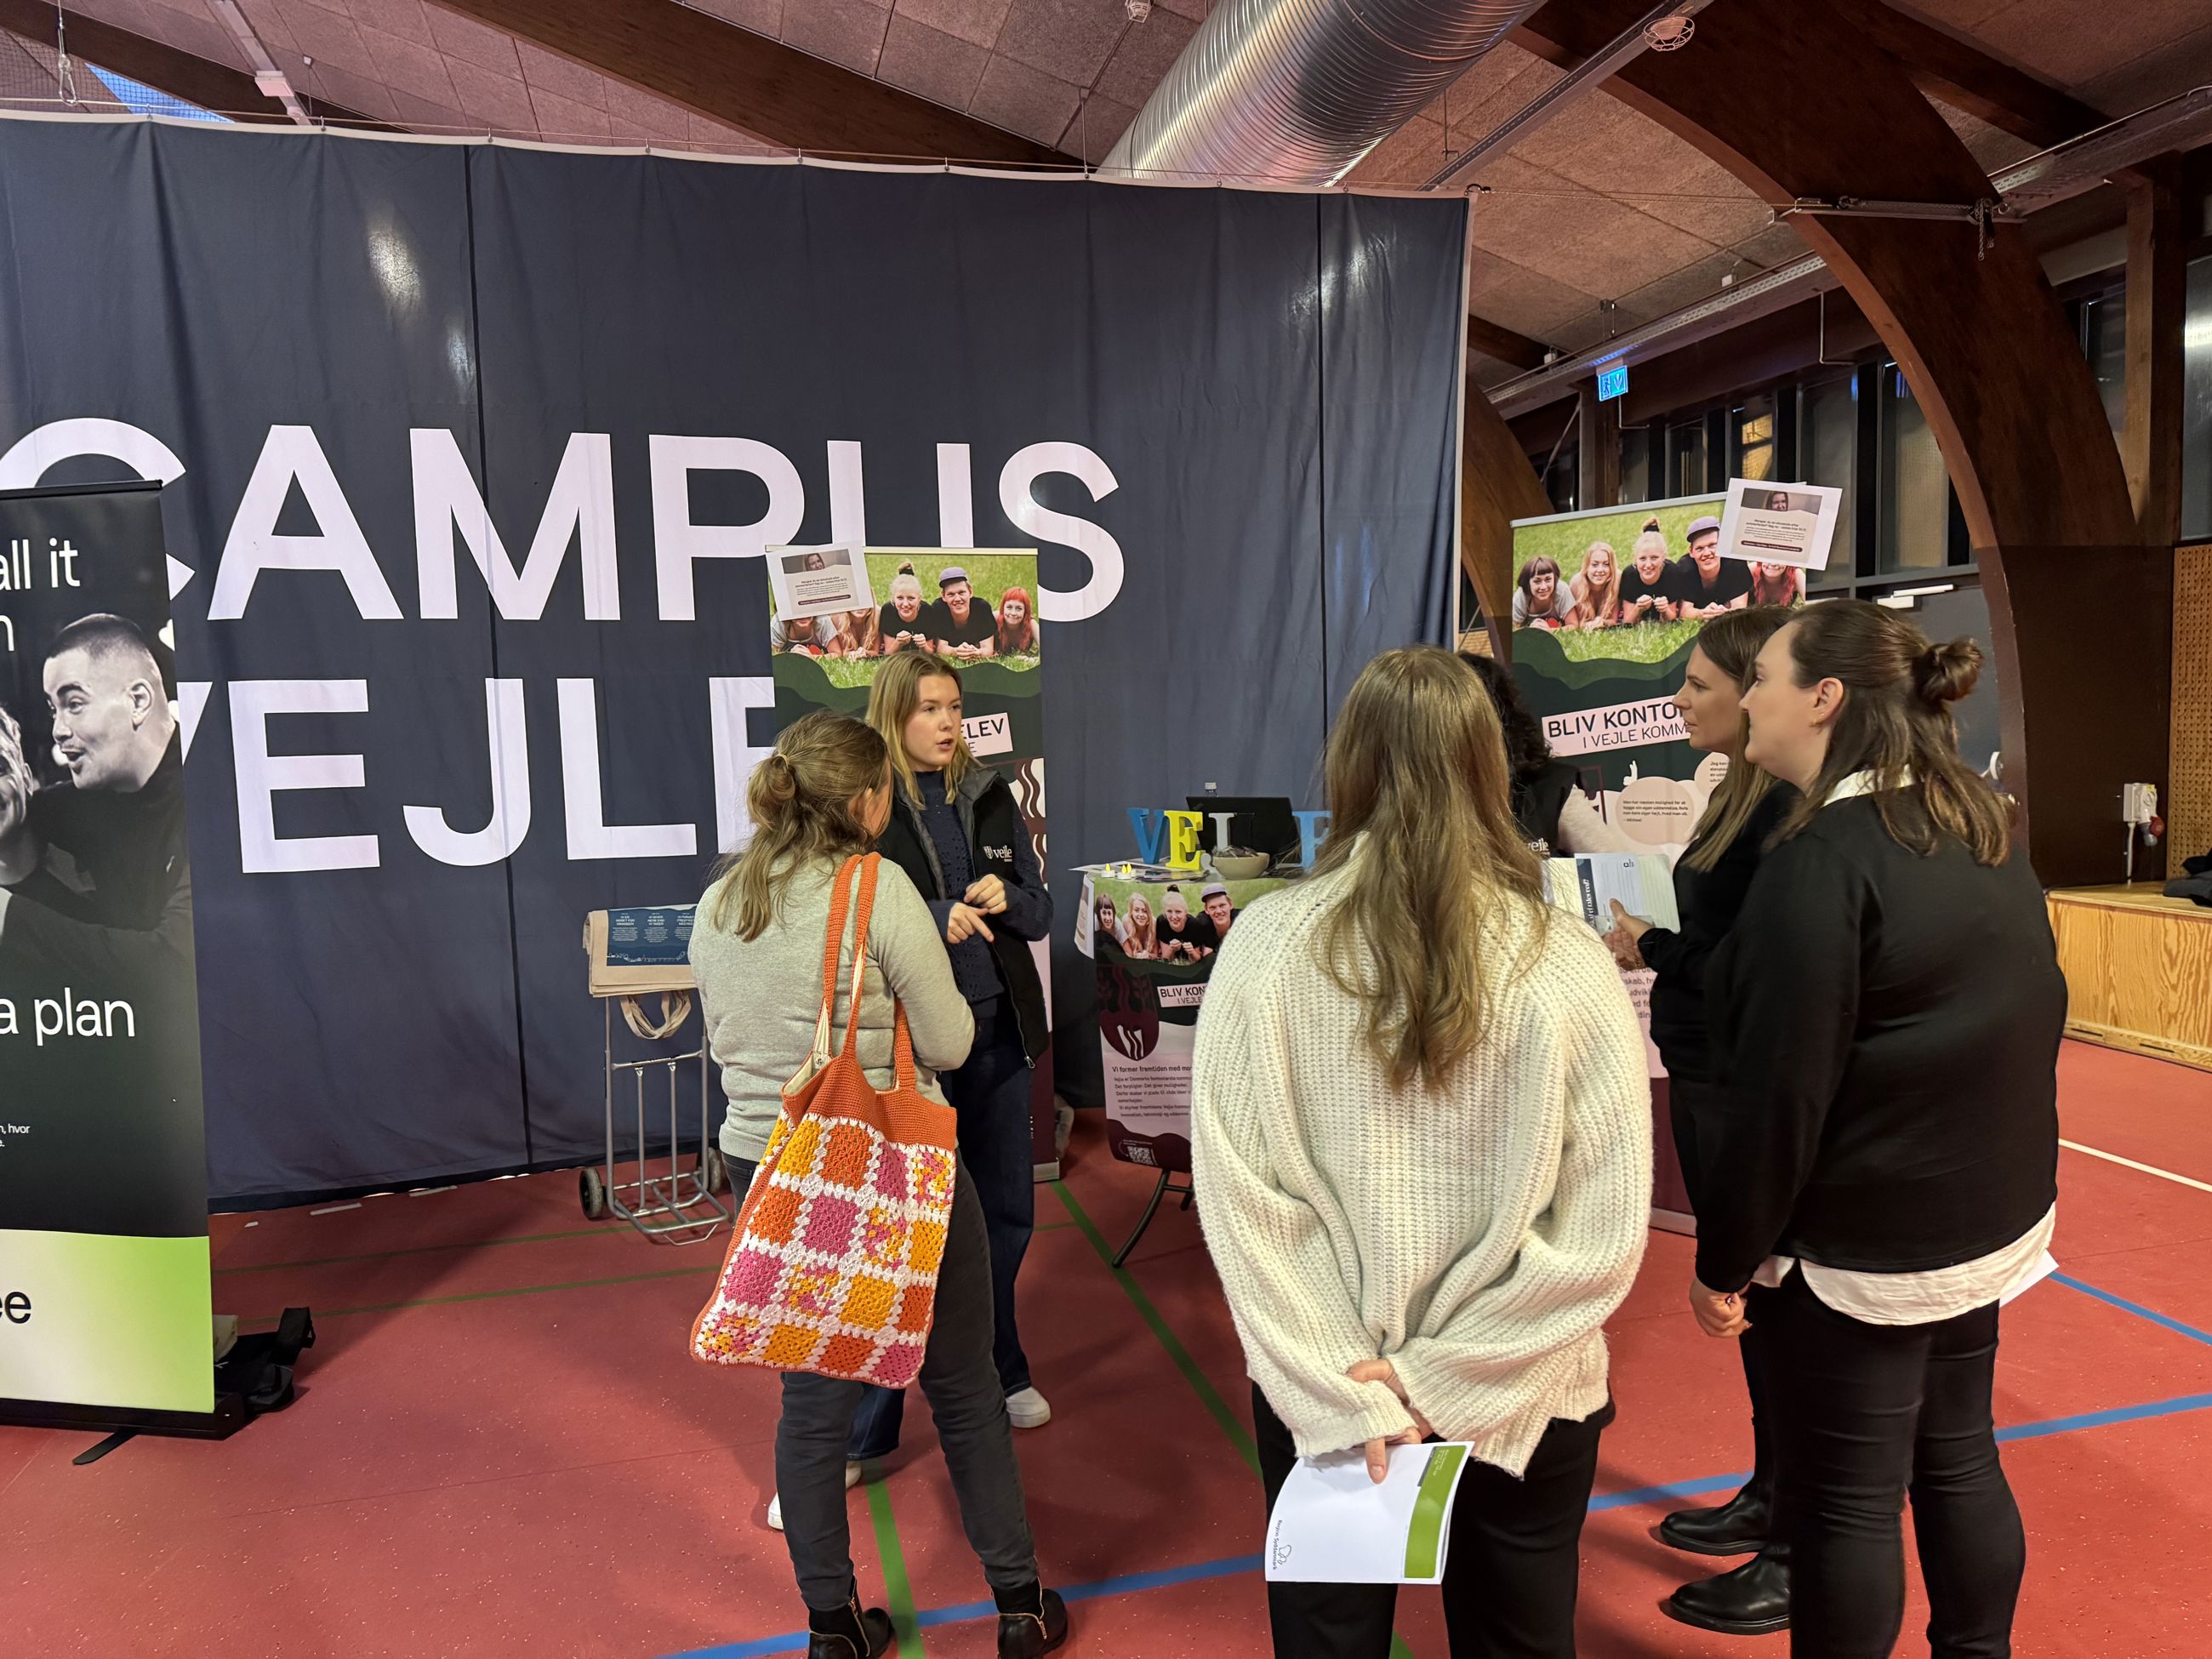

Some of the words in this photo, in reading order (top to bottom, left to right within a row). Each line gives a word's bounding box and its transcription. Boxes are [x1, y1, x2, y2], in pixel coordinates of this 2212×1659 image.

[48, 538, 81, 588] it
[1548, 714, 1596, 738] BLIV
[1582, 737, 1588, 749] I
[1591, 728, 1638, 747] VEJLE
[177, 677, 775, 874] EJLE
[1160, 987, 1183, 998] BLIV
[1185, 986, 1206, 996] KON
[34, 987, 135, 1046] plan
[8, 1123, 31, 1134] hvor
